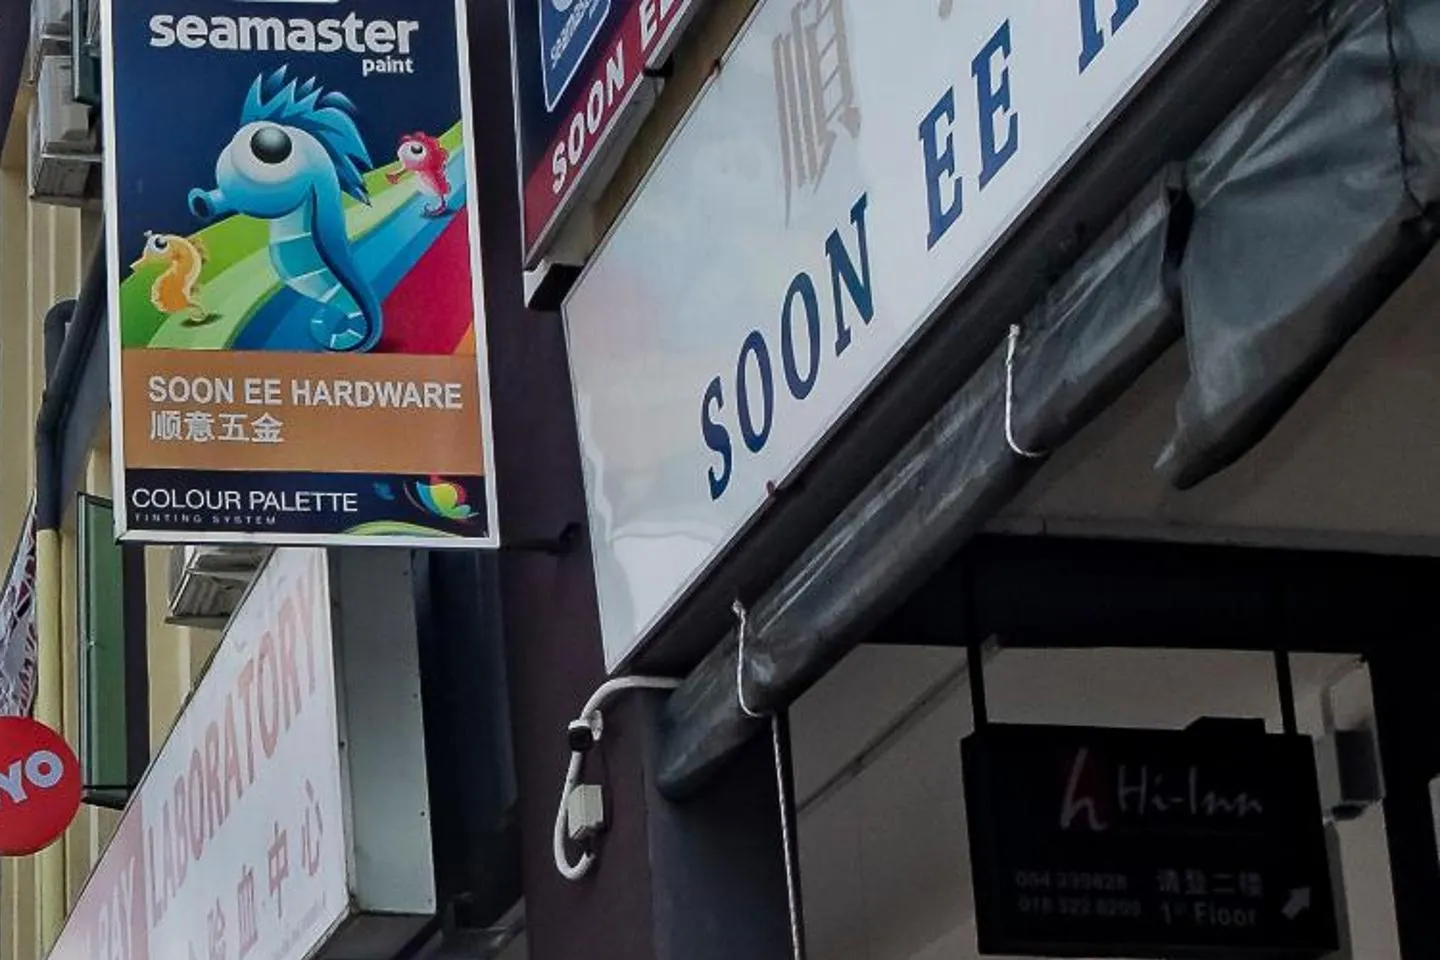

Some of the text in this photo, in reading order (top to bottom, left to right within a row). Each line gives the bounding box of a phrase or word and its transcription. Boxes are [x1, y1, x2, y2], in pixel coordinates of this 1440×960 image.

[148, 12, 420, 54] seamaster
[362, 56, 414, 77] paint
[552, 40, 626, 195] SOON
[701, 18, 1018, 501] SOON EE
[148, 376, 463, 410] SOON EE HARDWARE
[149, 411, 285, 444] 顺意五金
[132, 487, 359, 513] COLOUR PALETTE
[134, 512, 277, 526] TINTING SYSTEM
[148, 559, 317, 930] LABORATORY
